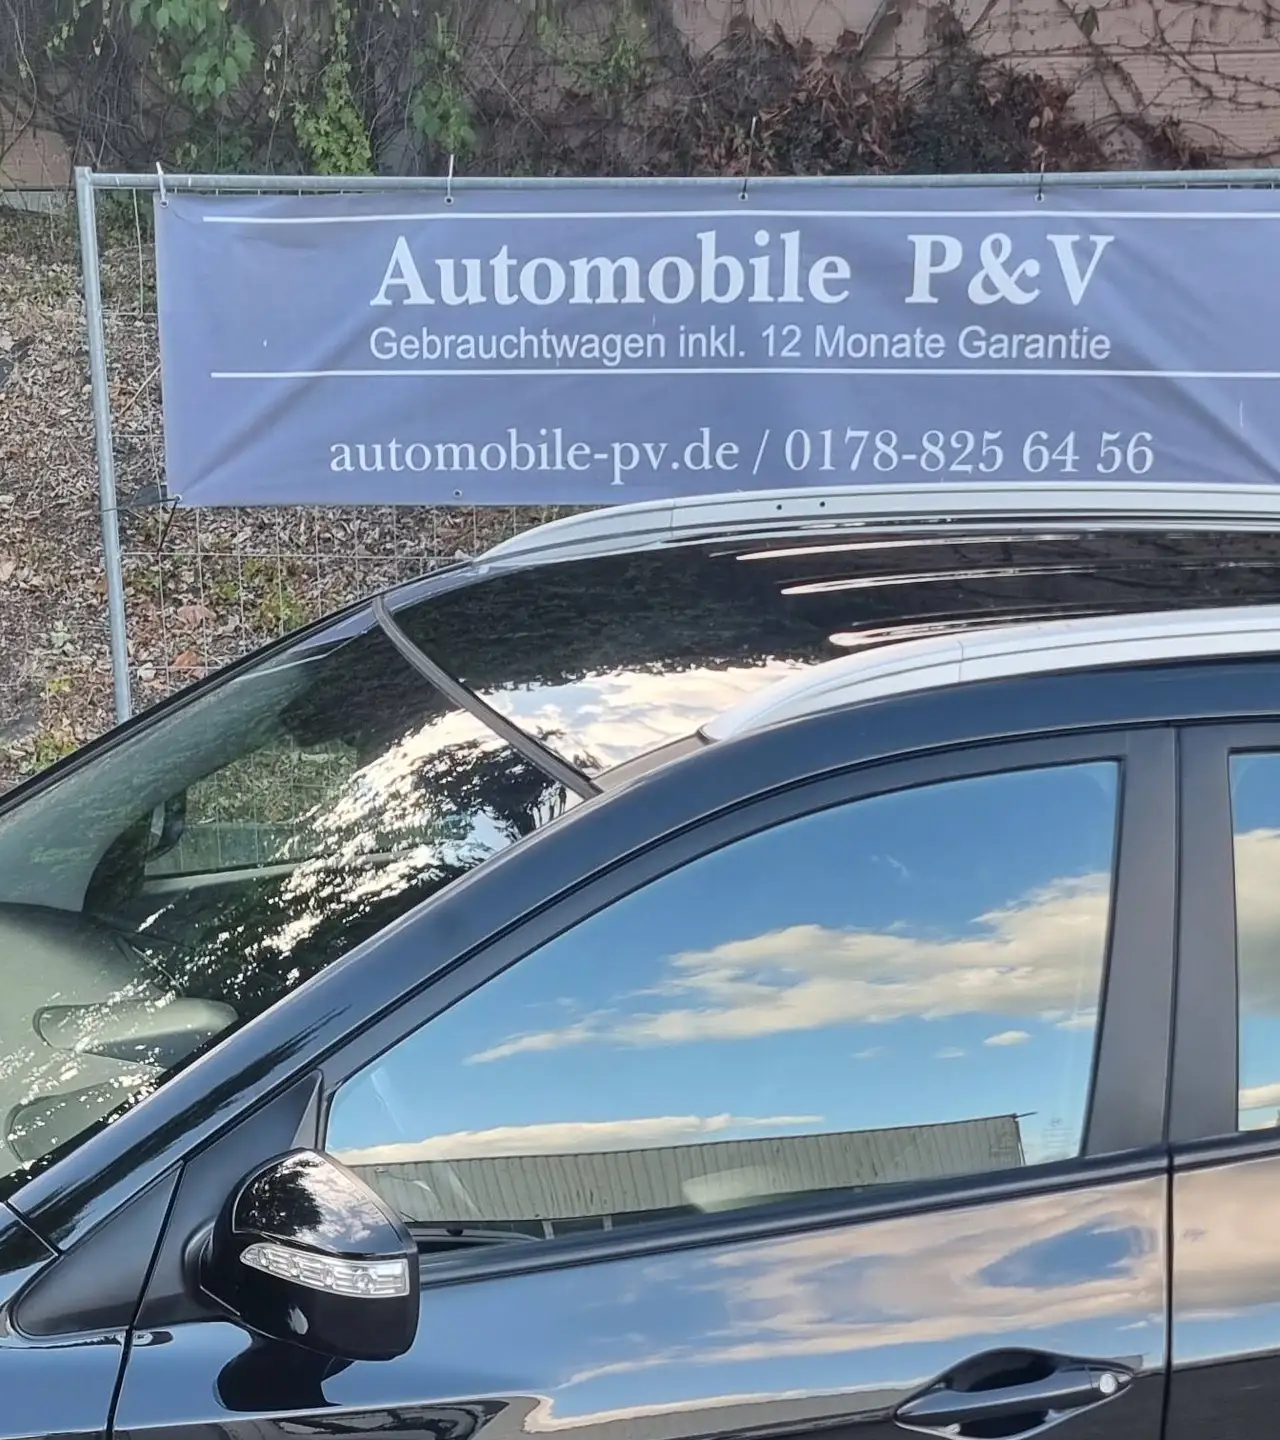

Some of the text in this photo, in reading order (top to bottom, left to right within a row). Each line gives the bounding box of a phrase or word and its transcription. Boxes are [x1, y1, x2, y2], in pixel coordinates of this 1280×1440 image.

[369, 229, 1115, 306] Automobile P&V
[369, 324, 1111, 366] Gebrauchtwagen inkl. 12 Monate Garantie
[329, 427, 1154, 485] automobile-pv.de / 0178-825 64 56
